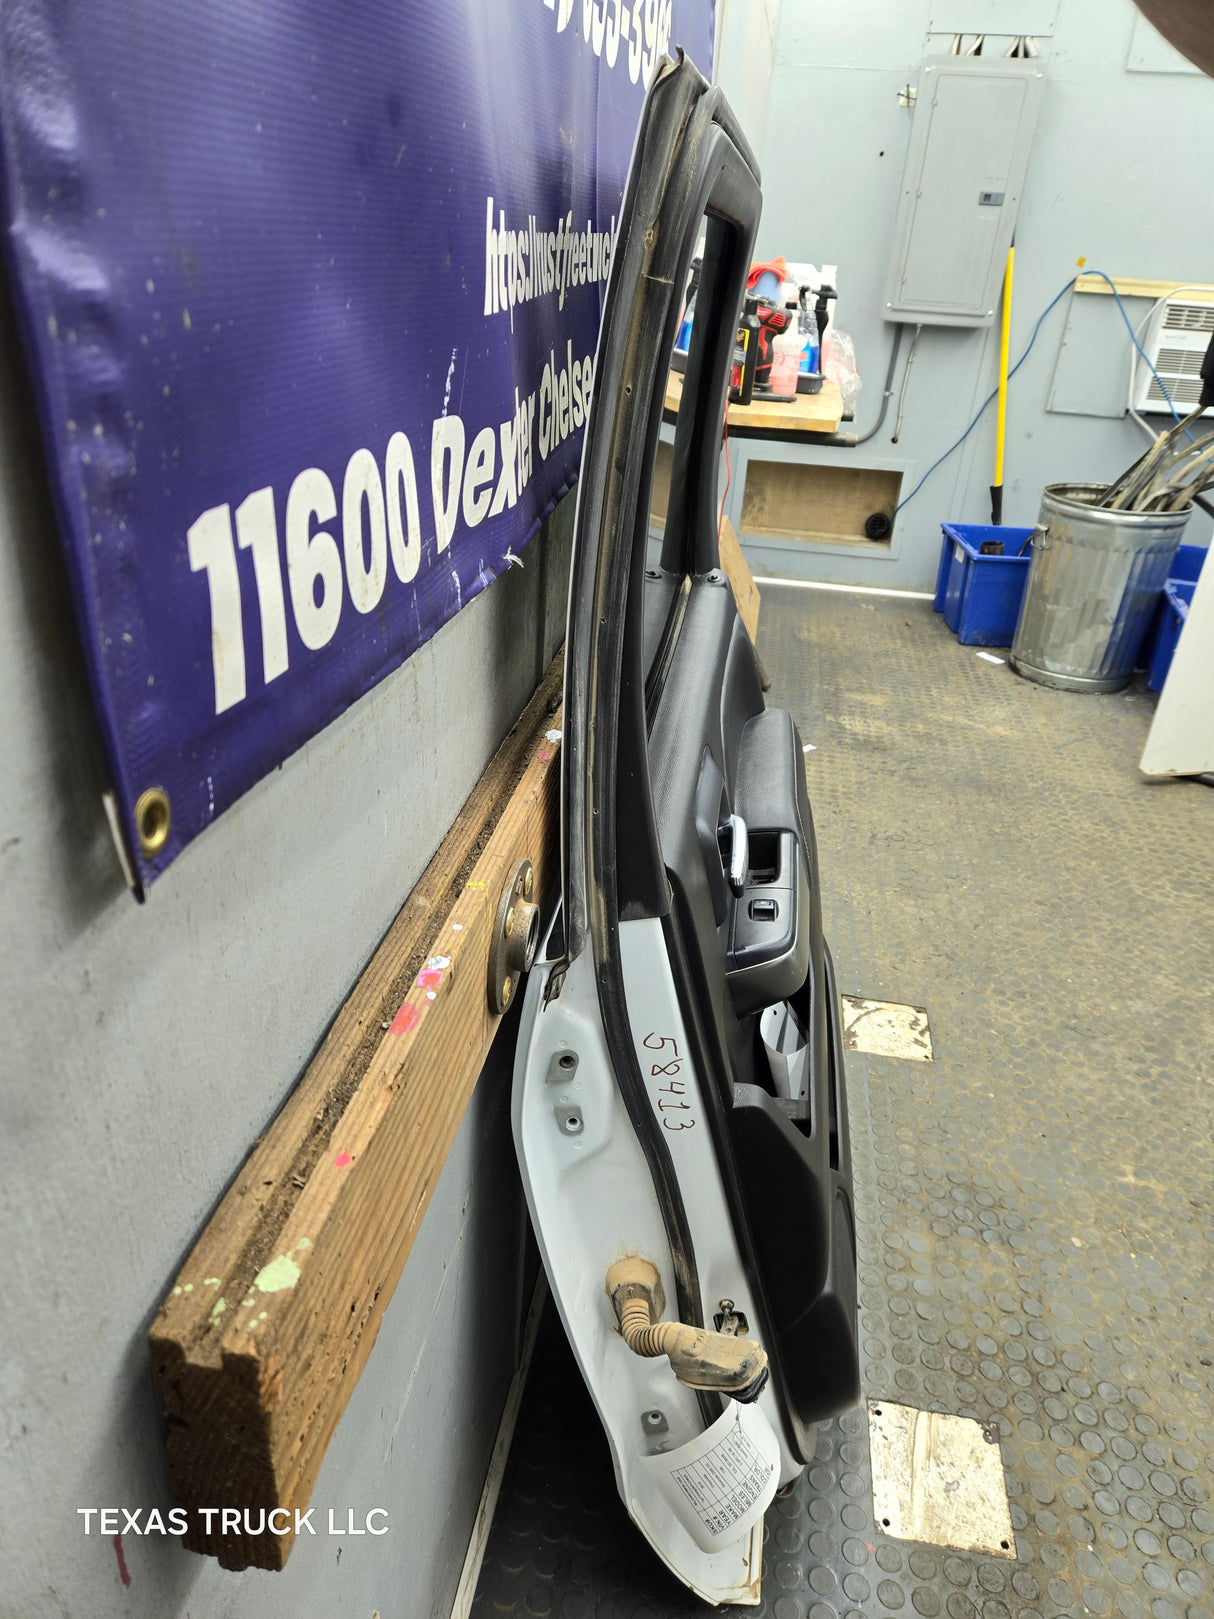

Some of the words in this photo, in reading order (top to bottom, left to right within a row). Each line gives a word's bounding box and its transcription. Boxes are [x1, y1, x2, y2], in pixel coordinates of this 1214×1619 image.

[187, 431, 421, 715] 11600
[431, 386, 535, 554] Dexter
[539, 339, 598, 461] Chelse
[643, 1032, 695, 1130] 58413
[740, 1479, 758, 1500] ENGINE
[747, 1473, 763, 1492] TRANS
[728, 1493, 745, 1513] MODEL
[737, 1489, 752, 1507] MILES
[718, 1508, 732, 1525] YEAR
[724, 1502, 739, 1519] MAKE
